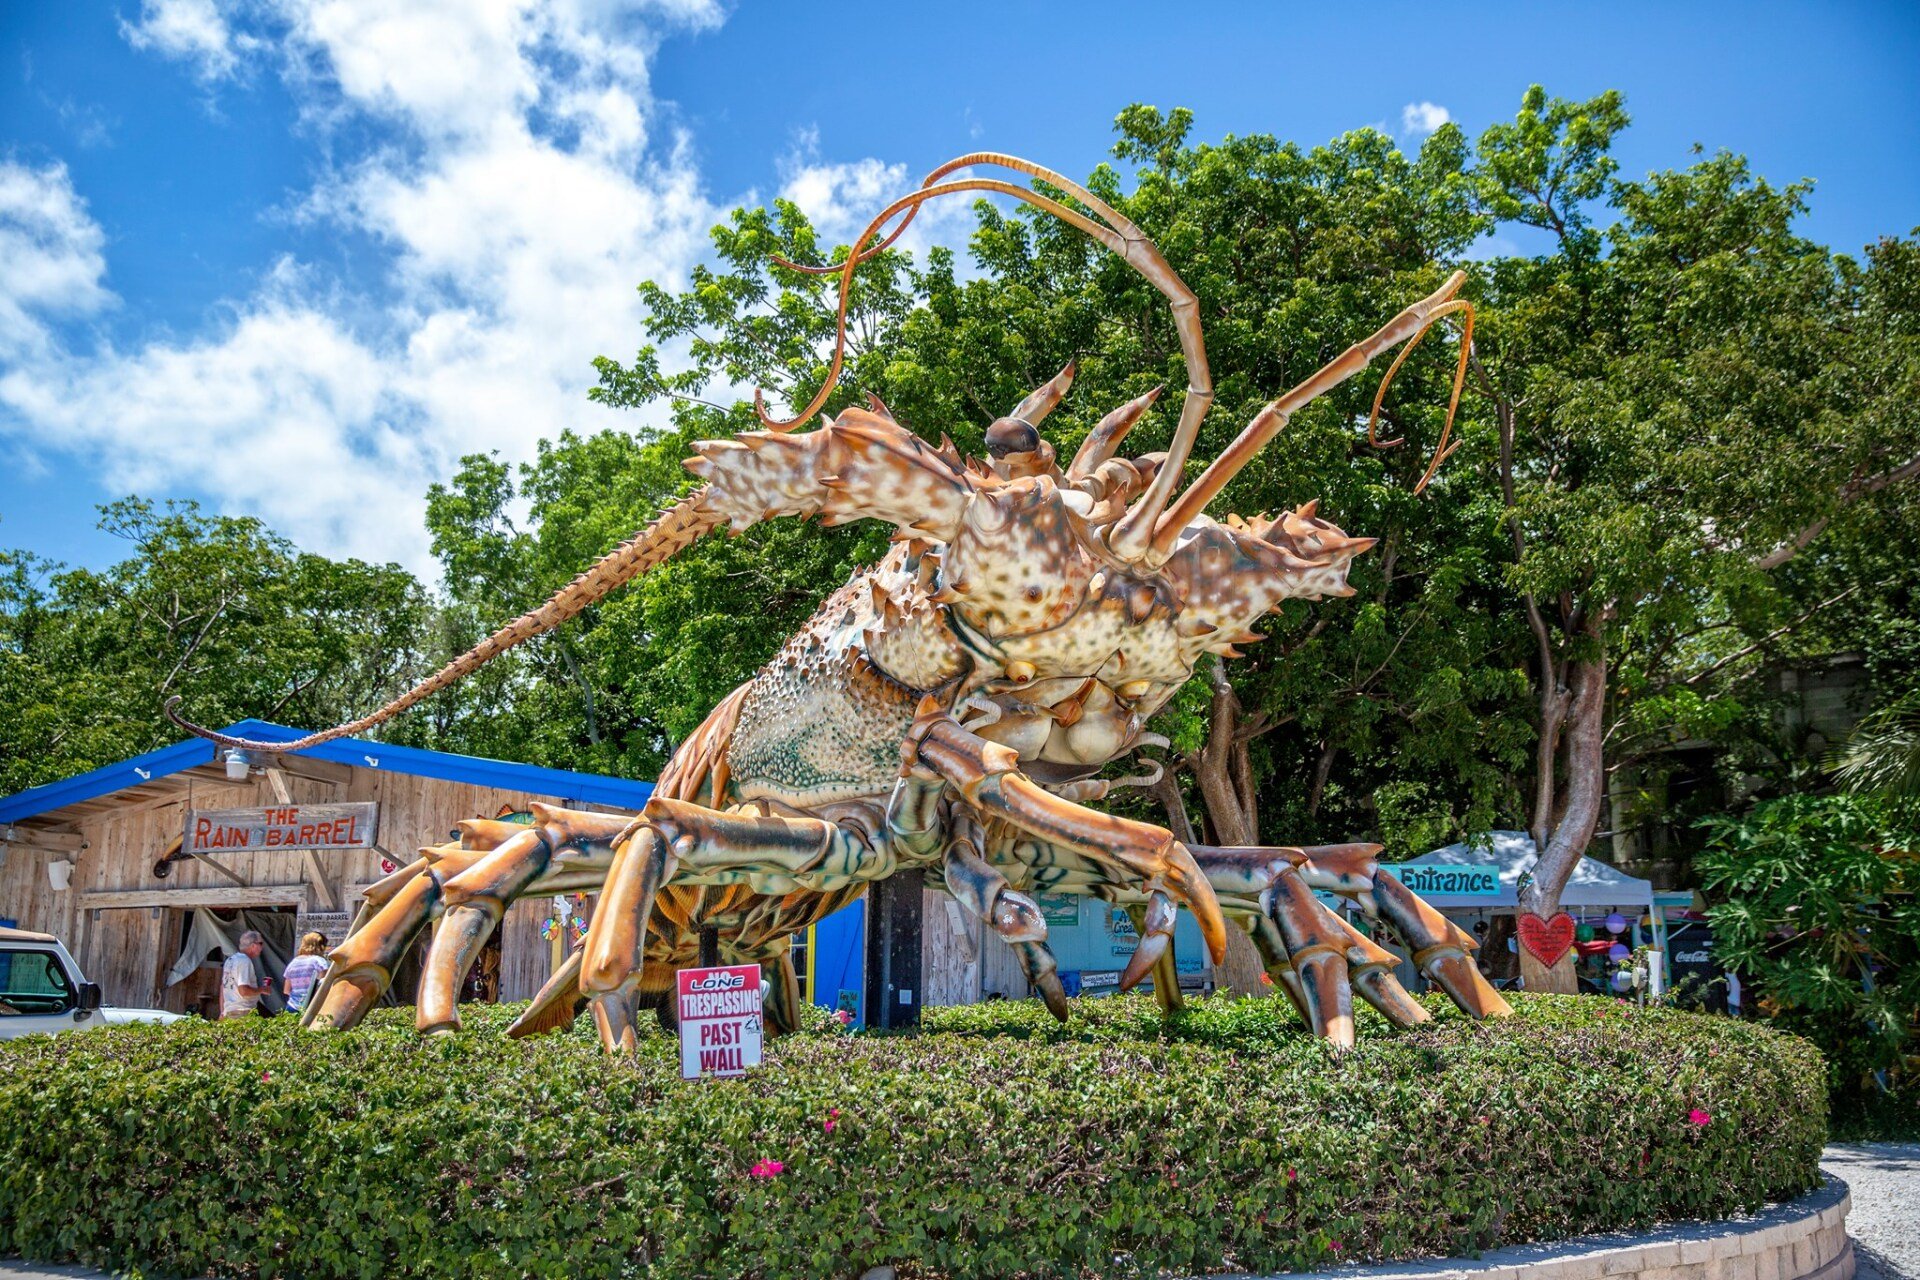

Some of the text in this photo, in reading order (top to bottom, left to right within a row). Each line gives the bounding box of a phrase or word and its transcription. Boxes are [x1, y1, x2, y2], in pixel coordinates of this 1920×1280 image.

[265, 808, 299, 825] THE
[194, 816, 364, 848] RAIN BARREL
[1400, 866, 1495, 892] Entrance
[691, 976, 744, 990] LONE
[682, 989, 760, 1018] TRESPASSING
[701, 1022, 742, 1046] PAST
[700, 1048, 744, 1072] WALL
